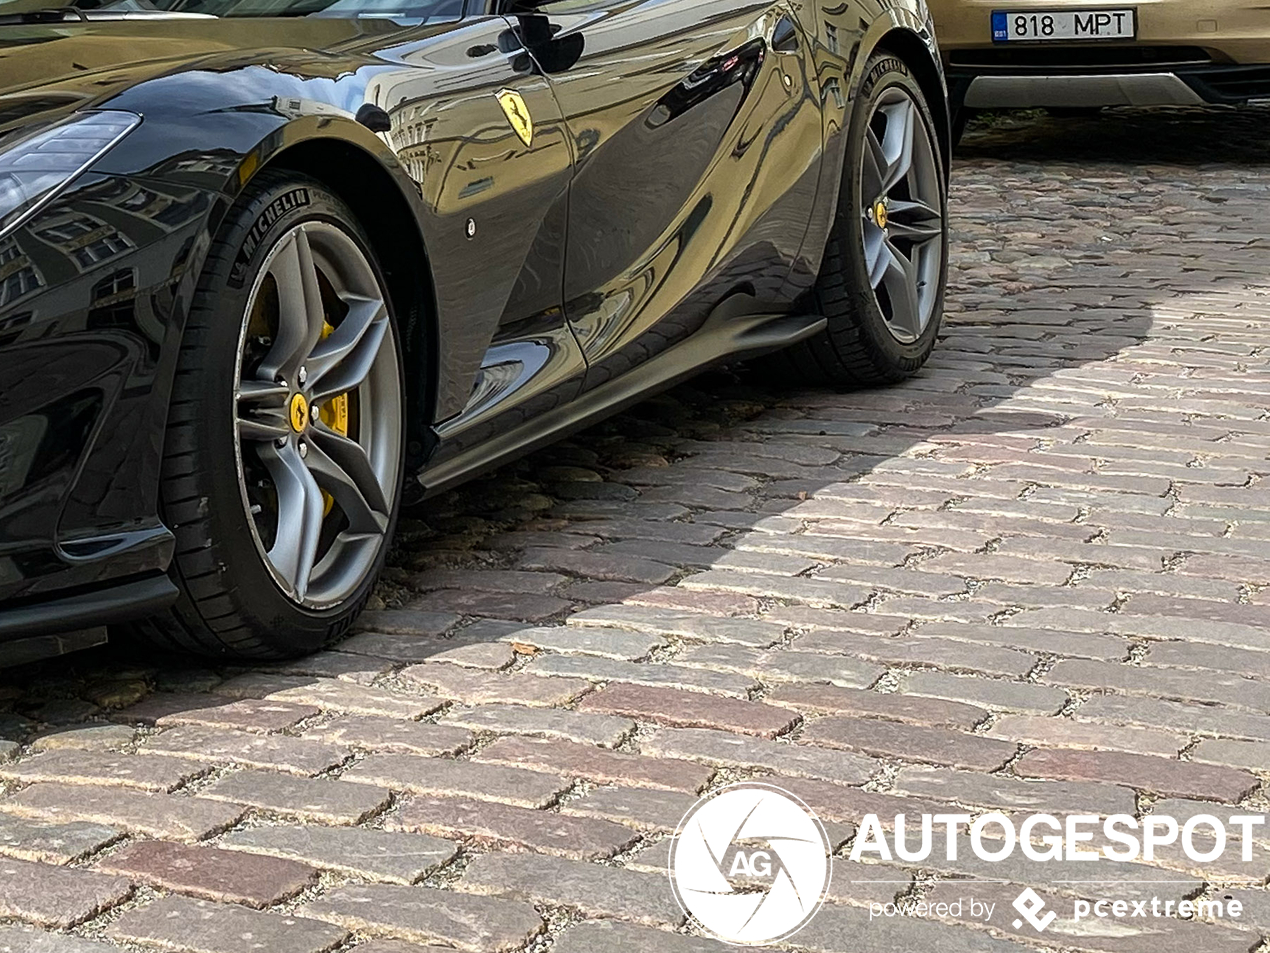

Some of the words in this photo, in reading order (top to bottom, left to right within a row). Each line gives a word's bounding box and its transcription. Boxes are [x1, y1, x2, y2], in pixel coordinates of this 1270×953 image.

[1015, 15, 1054, 36] 818
[1074, 13, 1126, 35] MPT
[243, 189, 307, 259] MICHELIN
